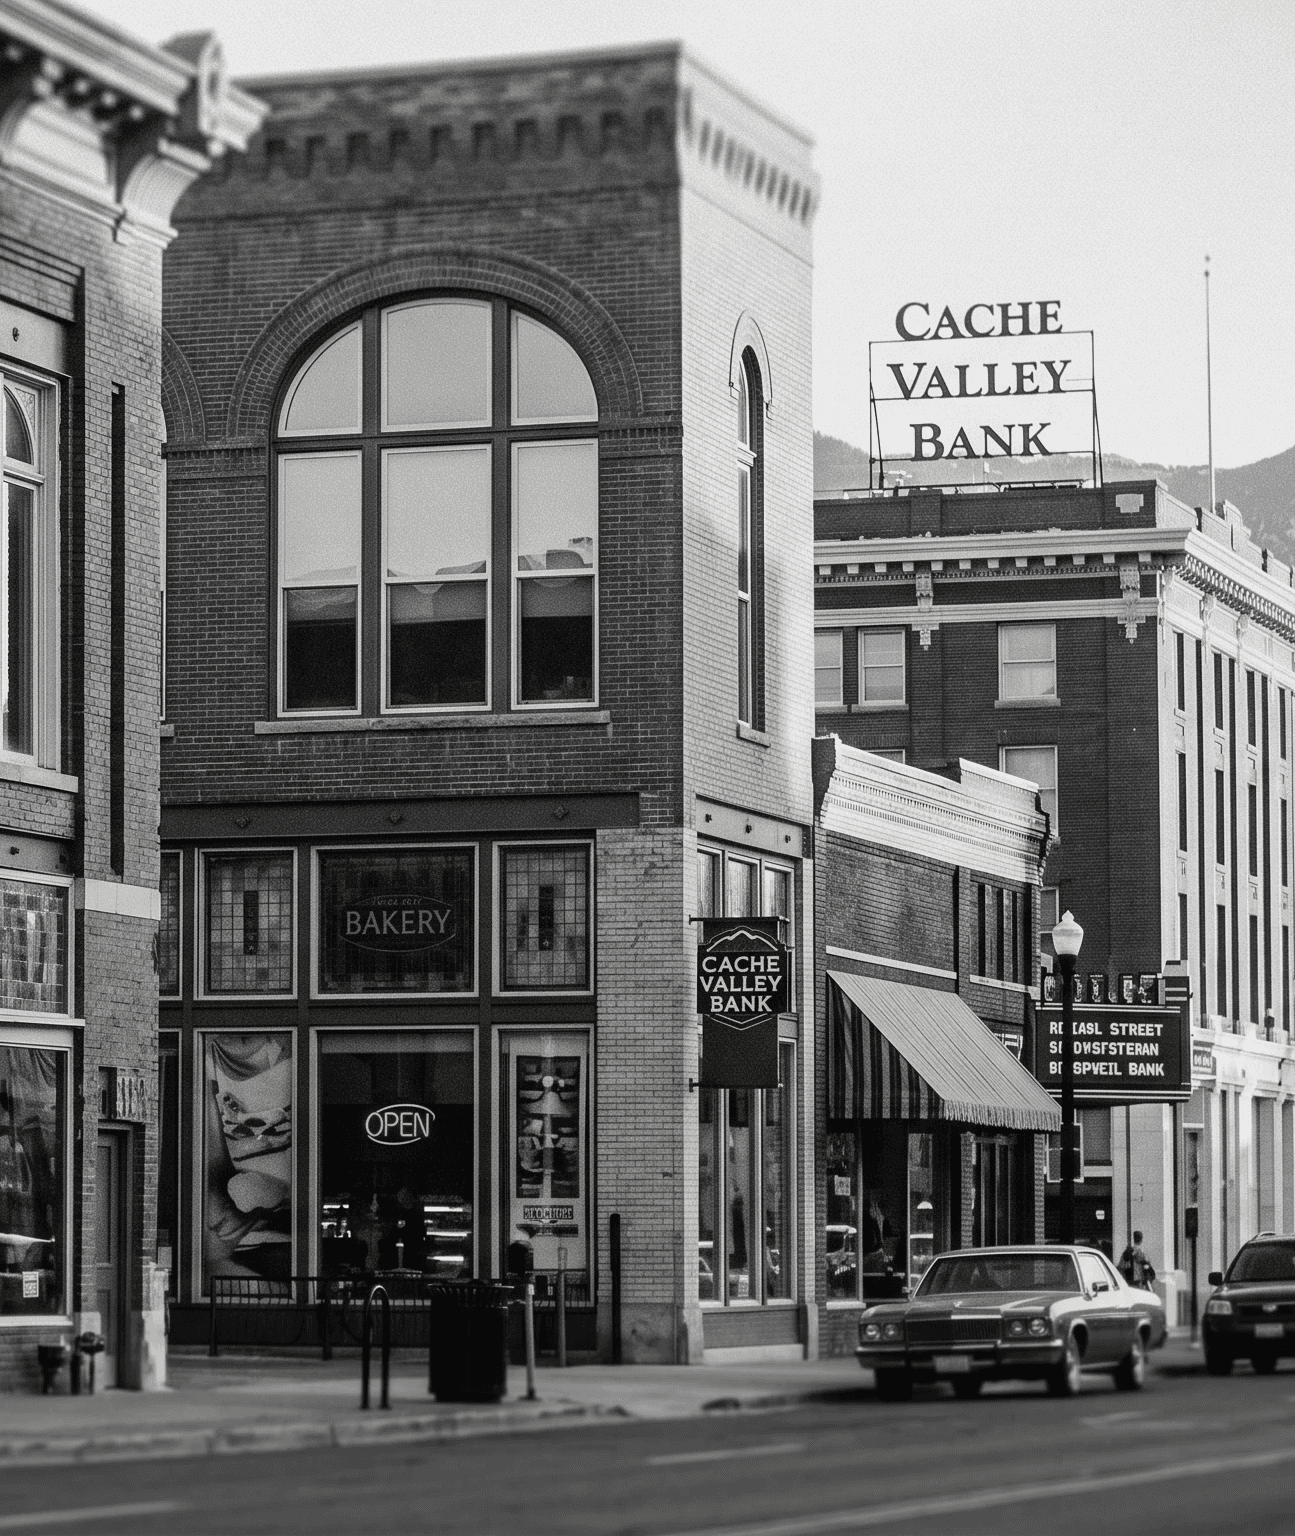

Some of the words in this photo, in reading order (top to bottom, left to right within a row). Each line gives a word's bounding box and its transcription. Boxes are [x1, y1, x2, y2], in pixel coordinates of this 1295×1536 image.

[895, 300, 1063, 341] CACHE
[886, 359, 1072, 400] VALLEY
[909, 422, 1052, 462] BANK
[345, 909, 452, 935] BAKERY
[701, 955, 780, 973] CACHE
[699, 975, 783, 993] VALLEY
[710, 995, 773, 1012] BANK
[1109, 1022, 1164, 1036] STREET
[1128, 1062, 1165, 1077] BANK
[365, 1111, 430, 1138] OPEN
